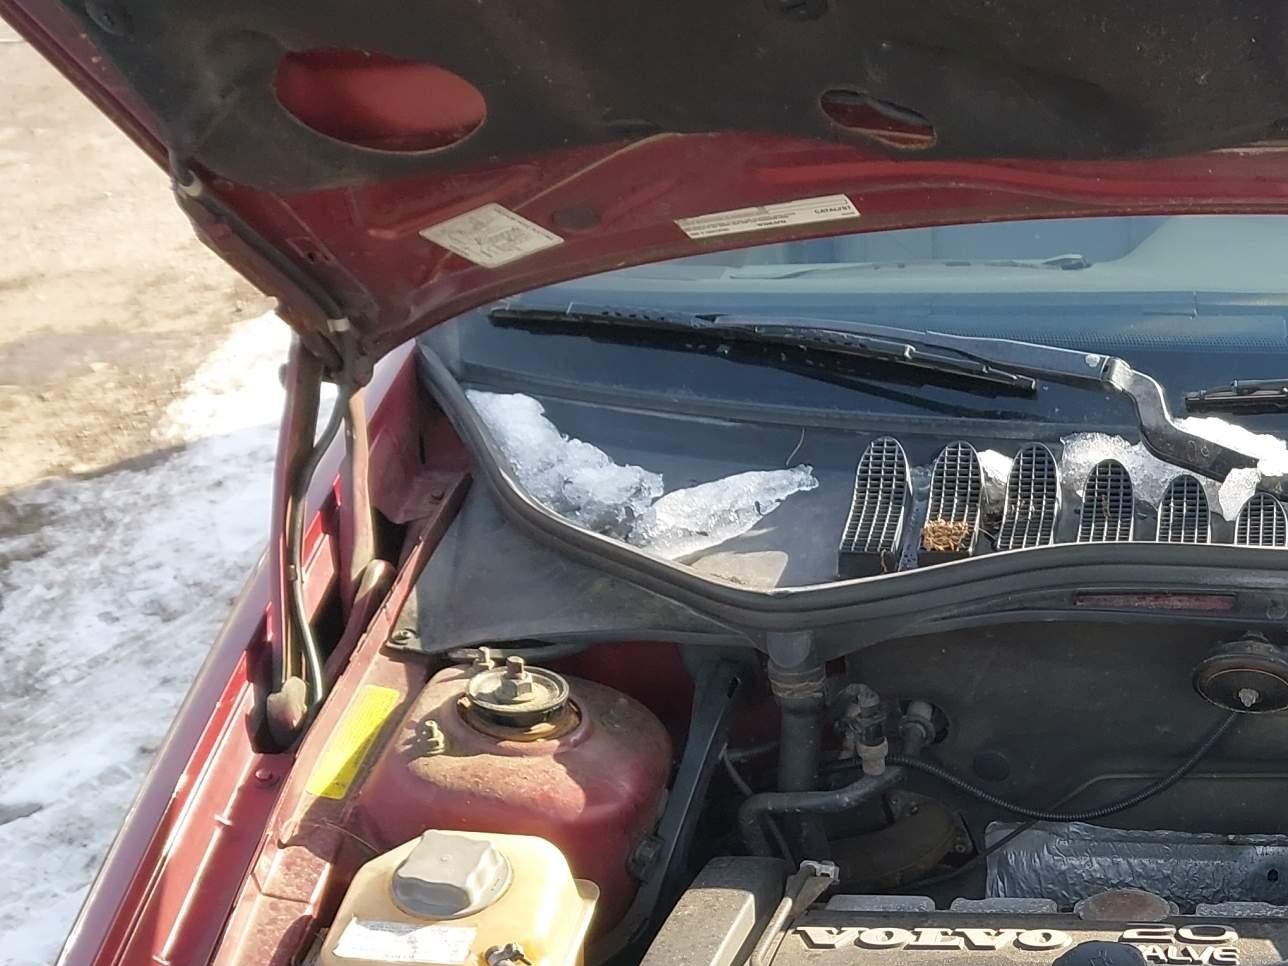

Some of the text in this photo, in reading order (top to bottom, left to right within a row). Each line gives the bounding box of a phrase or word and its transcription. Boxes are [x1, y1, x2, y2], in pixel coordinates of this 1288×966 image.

[797, 926, 1073, 950] VOLVO
[1118, 922, 1239, 944] 20
[1141, 944, 1240, 966] ALVE
